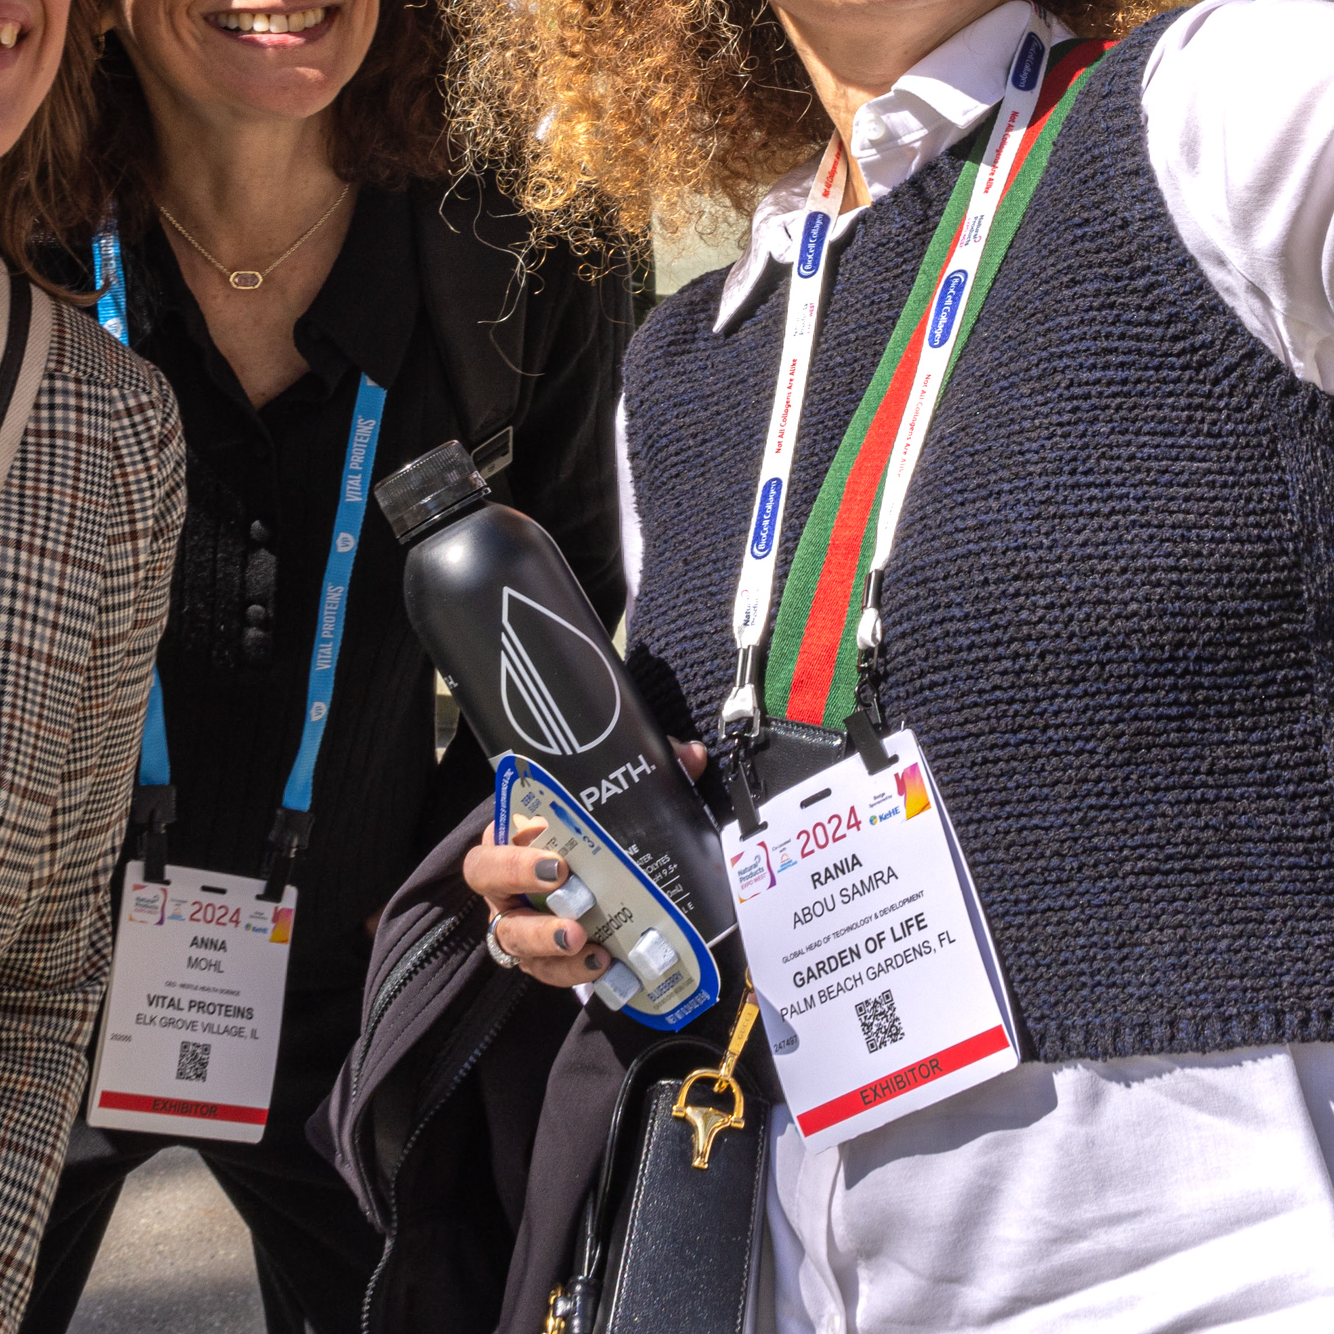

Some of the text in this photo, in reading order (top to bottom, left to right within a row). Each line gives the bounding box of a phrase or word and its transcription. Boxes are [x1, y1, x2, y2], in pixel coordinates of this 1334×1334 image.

[1018, 59, 1032, 88] Collagen
[981, 109, 1020, 196] Not All Collagens Are Alike
[804, 214, 823, 270] BioCell Collagen
[933, 277, 960, 346] BioCell Collagen
[919, 389, 927, 400] All
[922, 374, 932, 388] Not
[775, 358, 798, 454] Not All Collagens Are Alike
[345, 417, 376, 502] VITAL PROTEINS
[758, 479, 777, 550] BioCell Collagen
[315, 583, 344, 671] VITAL PROTEINS
[580, 754, 656, 814] PATH.
[796, 806, 862, 859] 2024
[878, 806, 900, 822] KeHE
[737, 861, 760, 877] Natural
[738, 867, 766, 883] Products
[811, 853, 863, 889] RANIA
[189, 901, 241, 928] 2024
[793, 866, 899, 929] ABOU SAMRA
[189, 936, 227, 953] ANNA
[782, 890, 924, 964] GLOBAL HEAD OF TECHNOLOGY & DEVELOPMENT
[187, 956, 224, 974] MOHL
[793, 912, 928, 988] GARDEN OF LIFE
[647, 970, 684, 1002] BLUEBERRY
[779, 930, 956, 1023] PALM BEACH GARDENS, FL
[135, 1012, 260, 1040] ELK GROVE VILLAGE, IL
[147, 993, 254, 1020] VITAL PROTEINS
[859, 1058, 944, 1108] EXHIBITOR
[152, 1098, 218, 1118] EXHIBITOR
